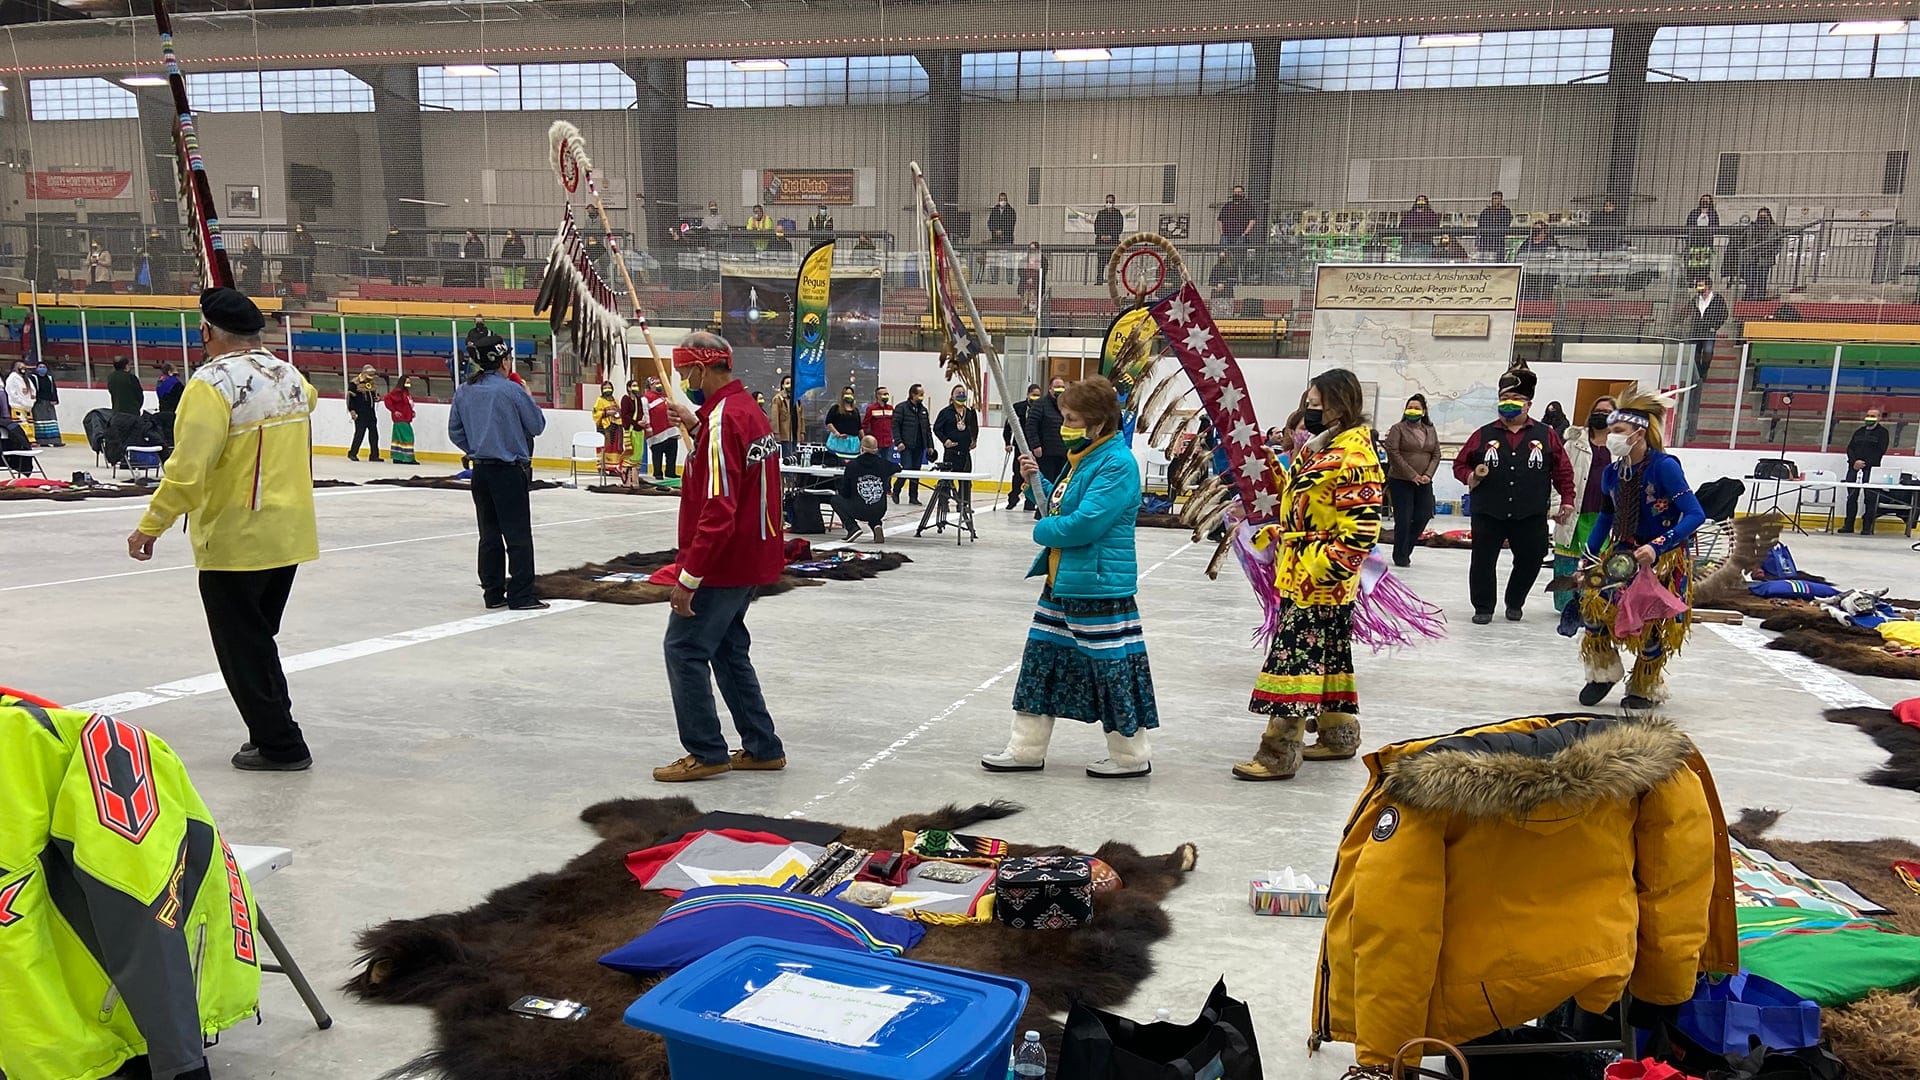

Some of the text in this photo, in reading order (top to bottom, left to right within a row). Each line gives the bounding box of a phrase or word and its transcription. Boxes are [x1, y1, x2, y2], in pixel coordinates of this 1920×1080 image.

[781, 178, 828, 193] Old Dutch
[1345, 270, 1492, 281] 1790's Pre-Contact Anishinaabe
[1348, 283, 1487, 296] Migration Route, Peguis Band
